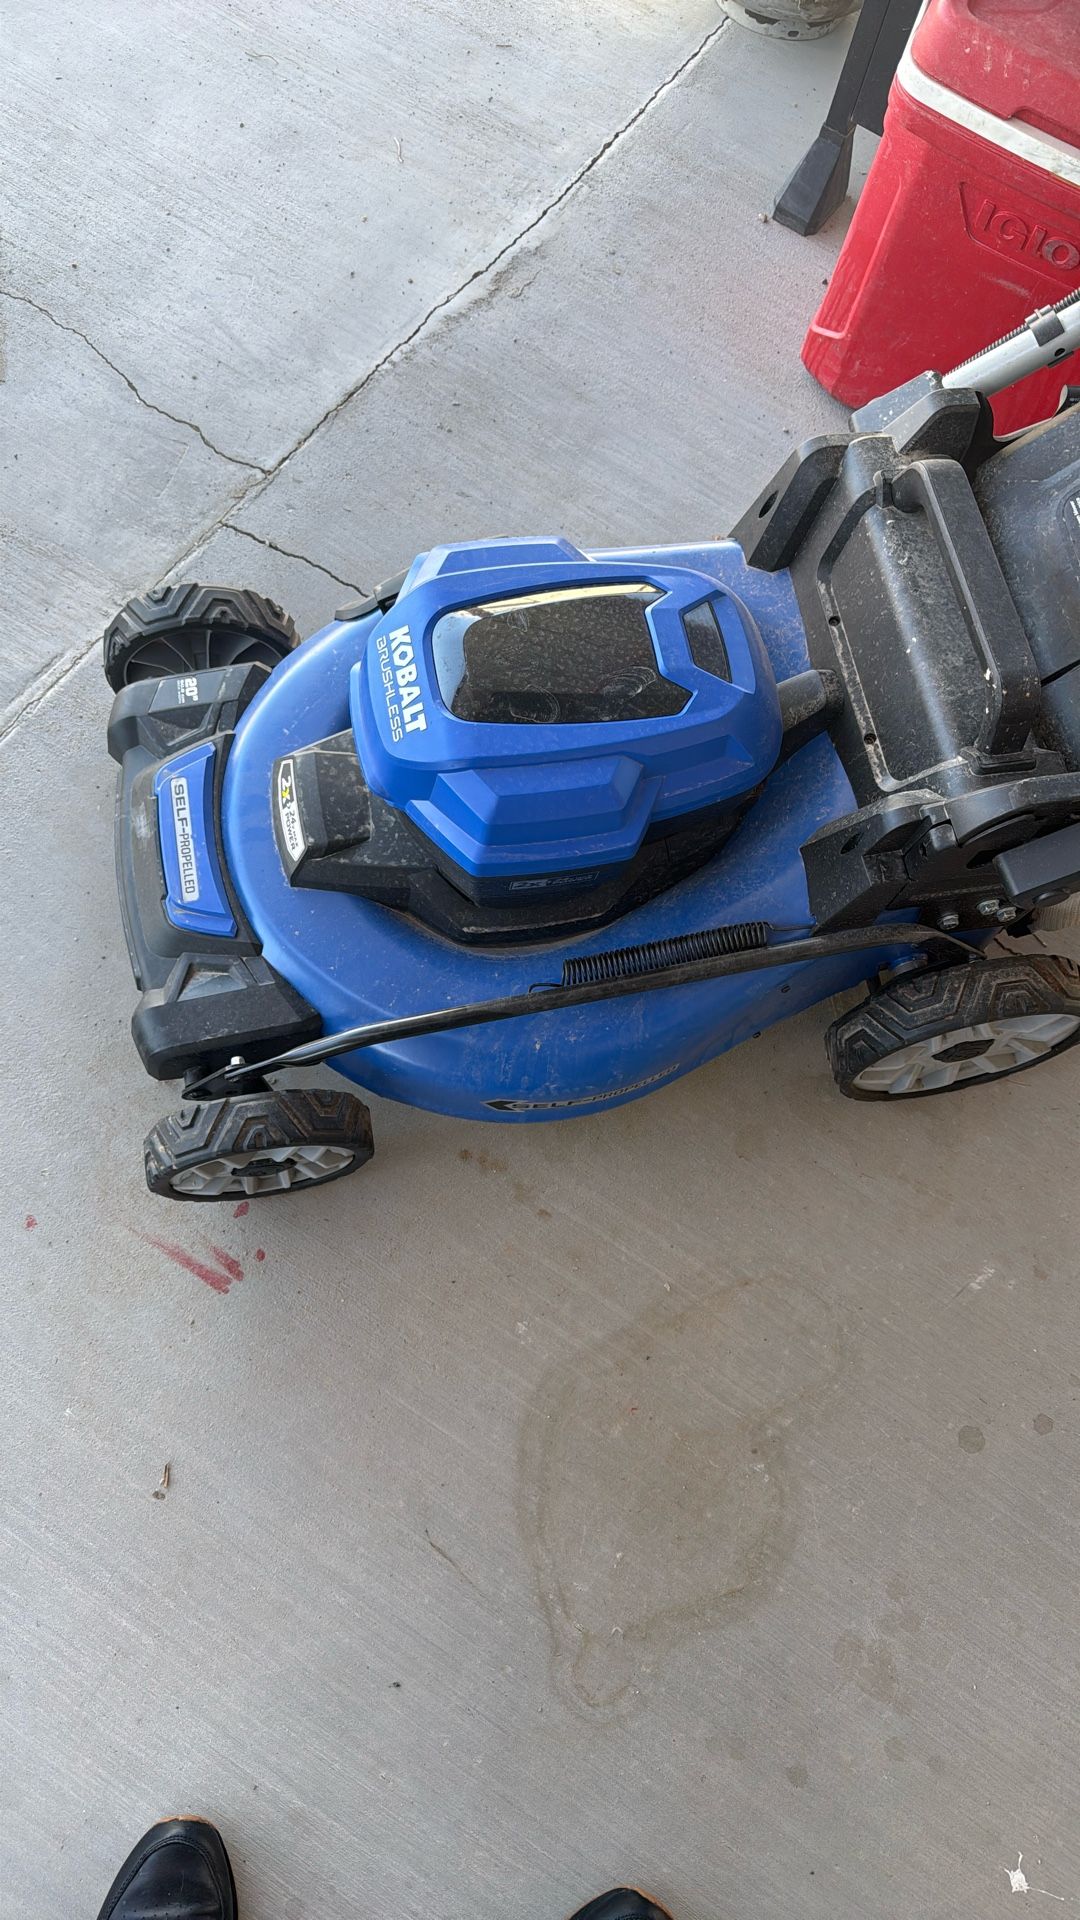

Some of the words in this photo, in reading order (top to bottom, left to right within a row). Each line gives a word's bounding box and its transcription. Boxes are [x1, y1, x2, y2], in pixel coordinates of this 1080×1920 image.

[376, 635, 403, 742] BRUSHLESS
[389, 625, 427, 733] KOBALT
[174, 784, 195, 893] SELF-PROPELLED
[285, 812, 295, 850] POWER
[511, 1063, 680, 1110] SELF-PROPELLED
